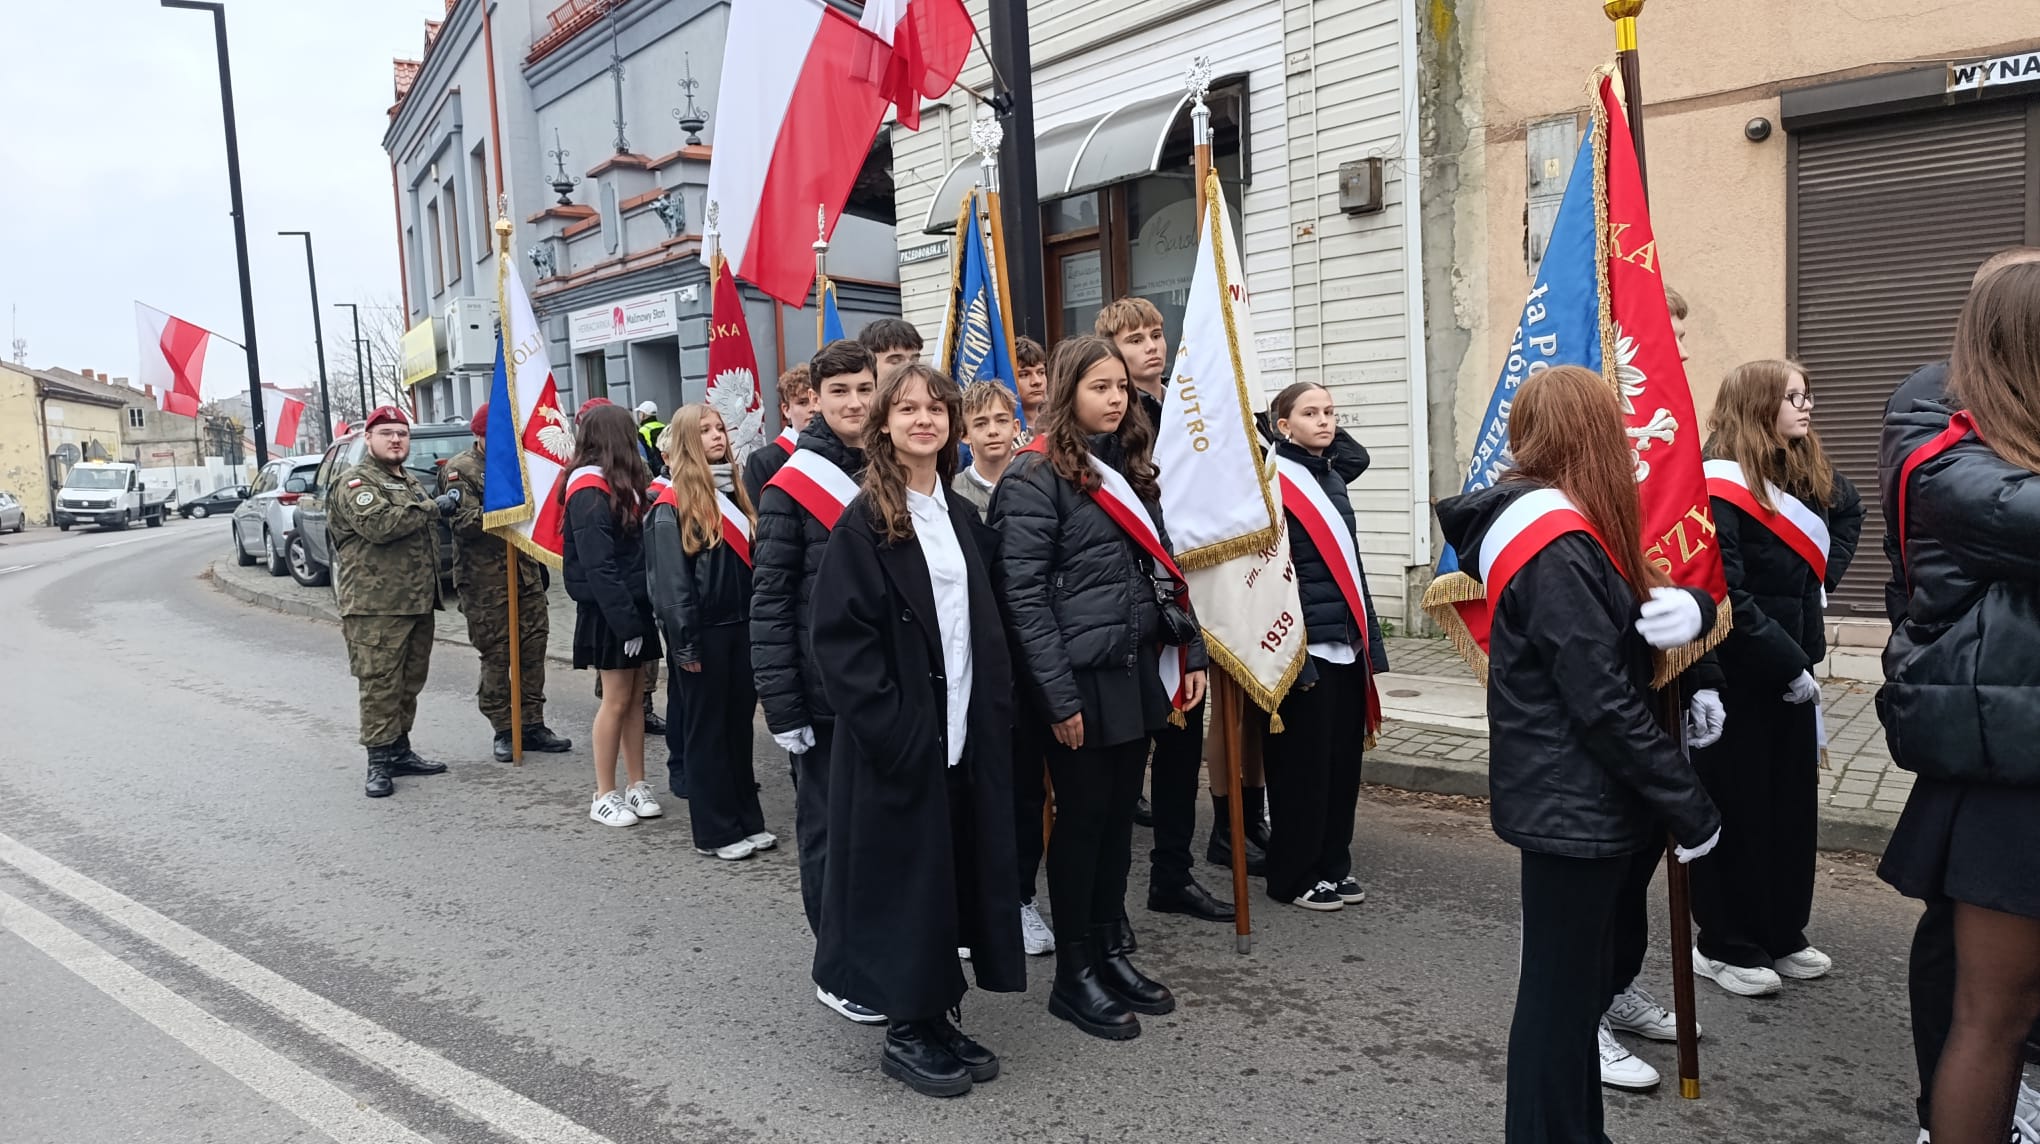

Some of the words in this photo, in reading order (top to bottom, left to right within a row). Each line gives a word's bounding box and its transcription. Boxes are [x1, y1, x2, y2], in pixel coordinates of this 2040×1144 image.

[1953, 55, 2040, 86] WYNA
[627, 311, 652, 325] Malinowy
[652, 307, 666, 320] Słoń
[1177, 373, 1209, 453] JUTRO
[1260, 611, 1295, 654] 1939
